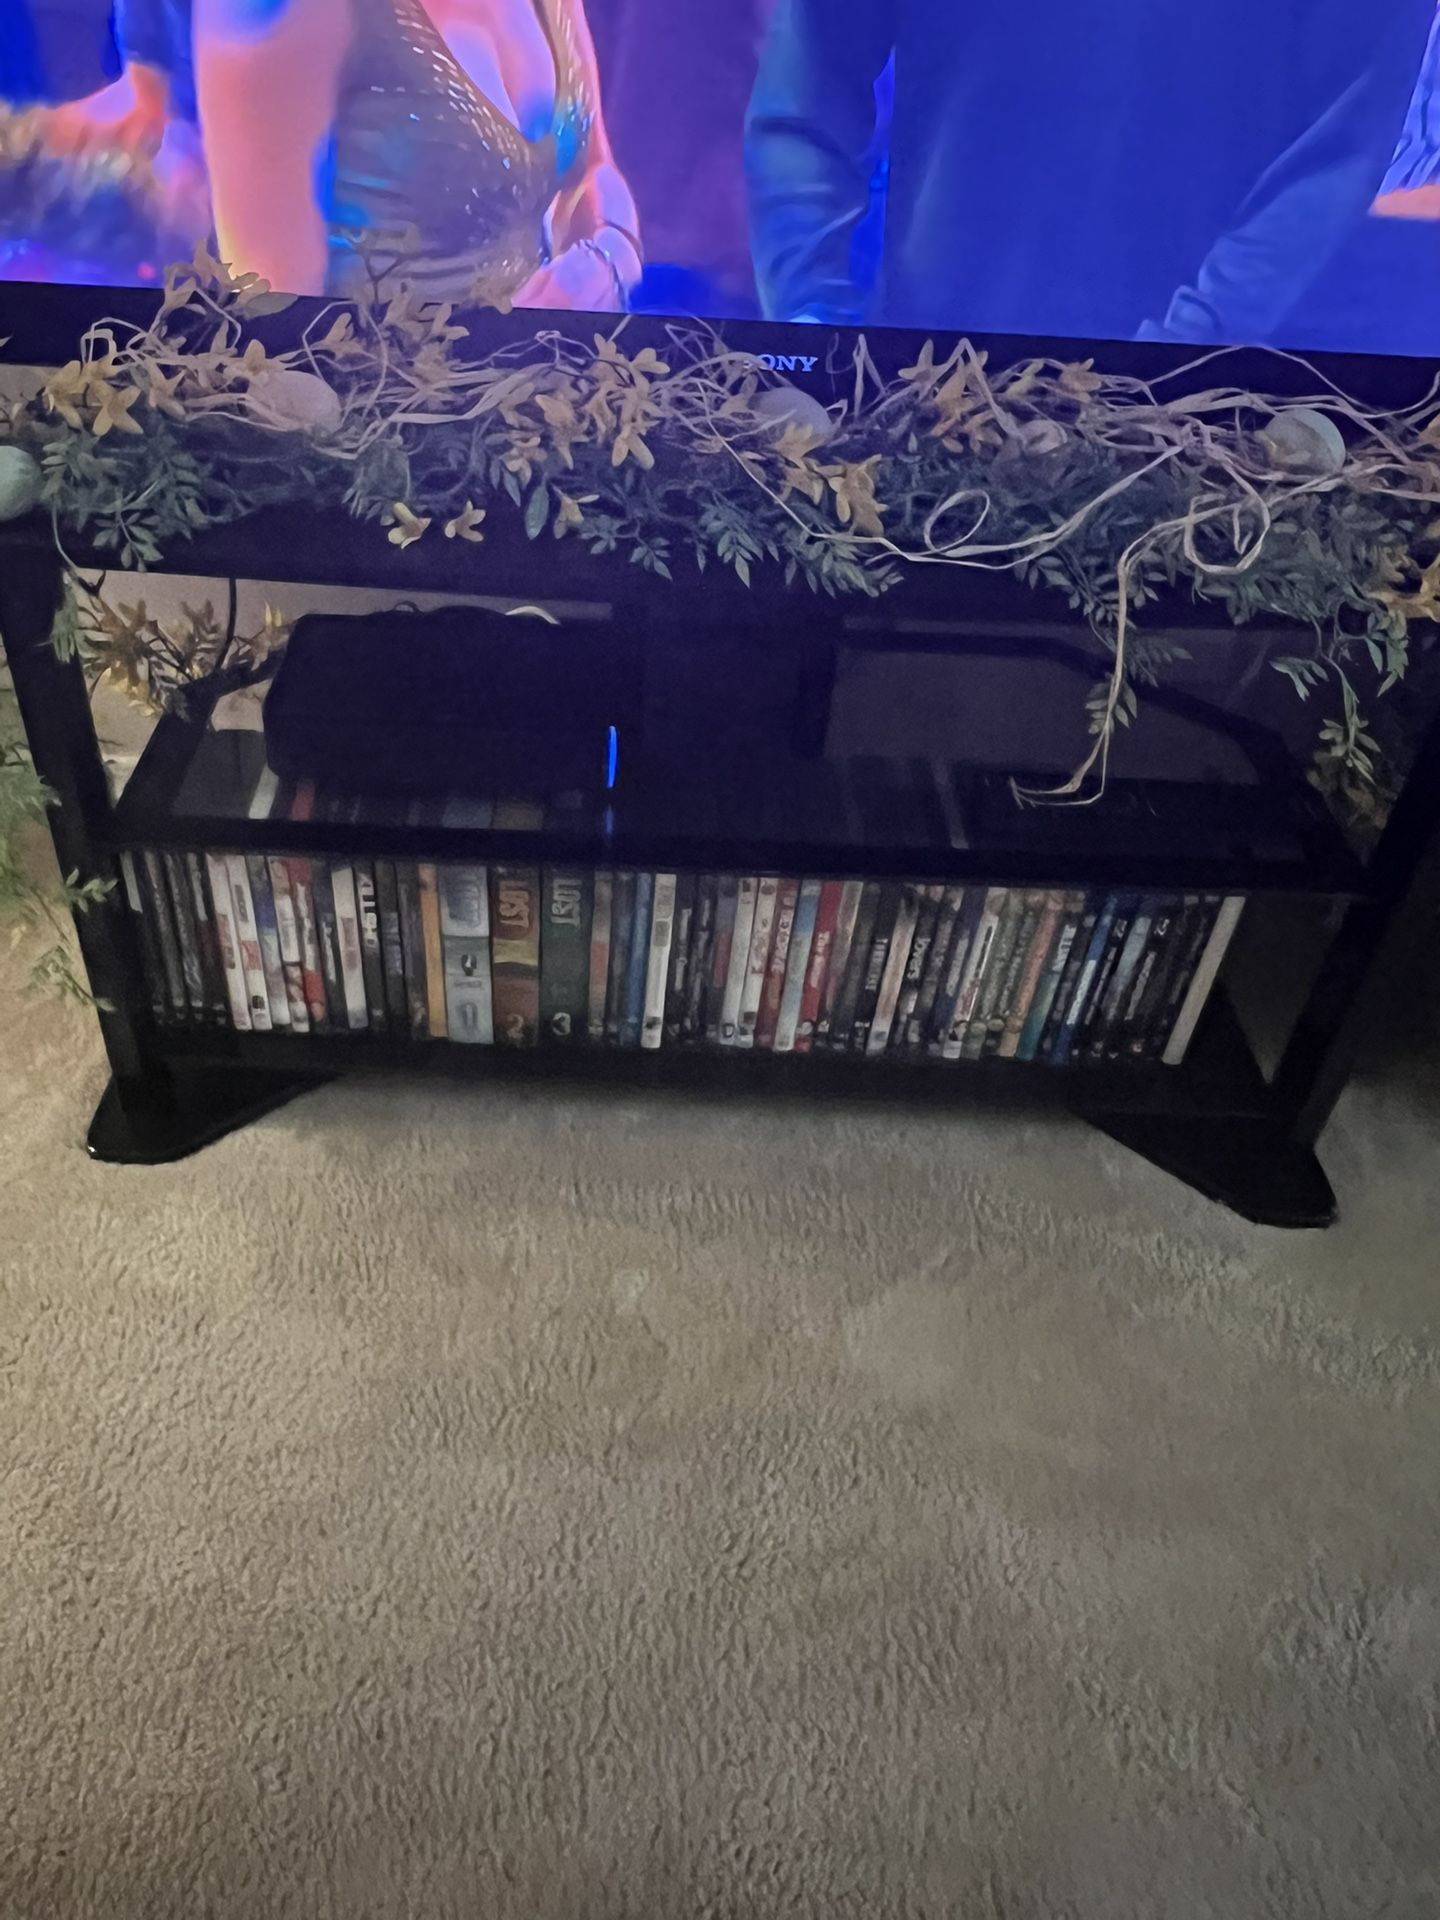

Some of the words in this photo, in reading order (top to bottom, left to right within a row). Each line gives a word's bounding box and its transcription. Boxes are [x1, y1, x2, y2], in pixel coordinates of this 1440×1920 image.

[754, 353, 818, 372] ONY
[499, 879, 529, 928] LOST
[551, 878, 582, 928] LOST
